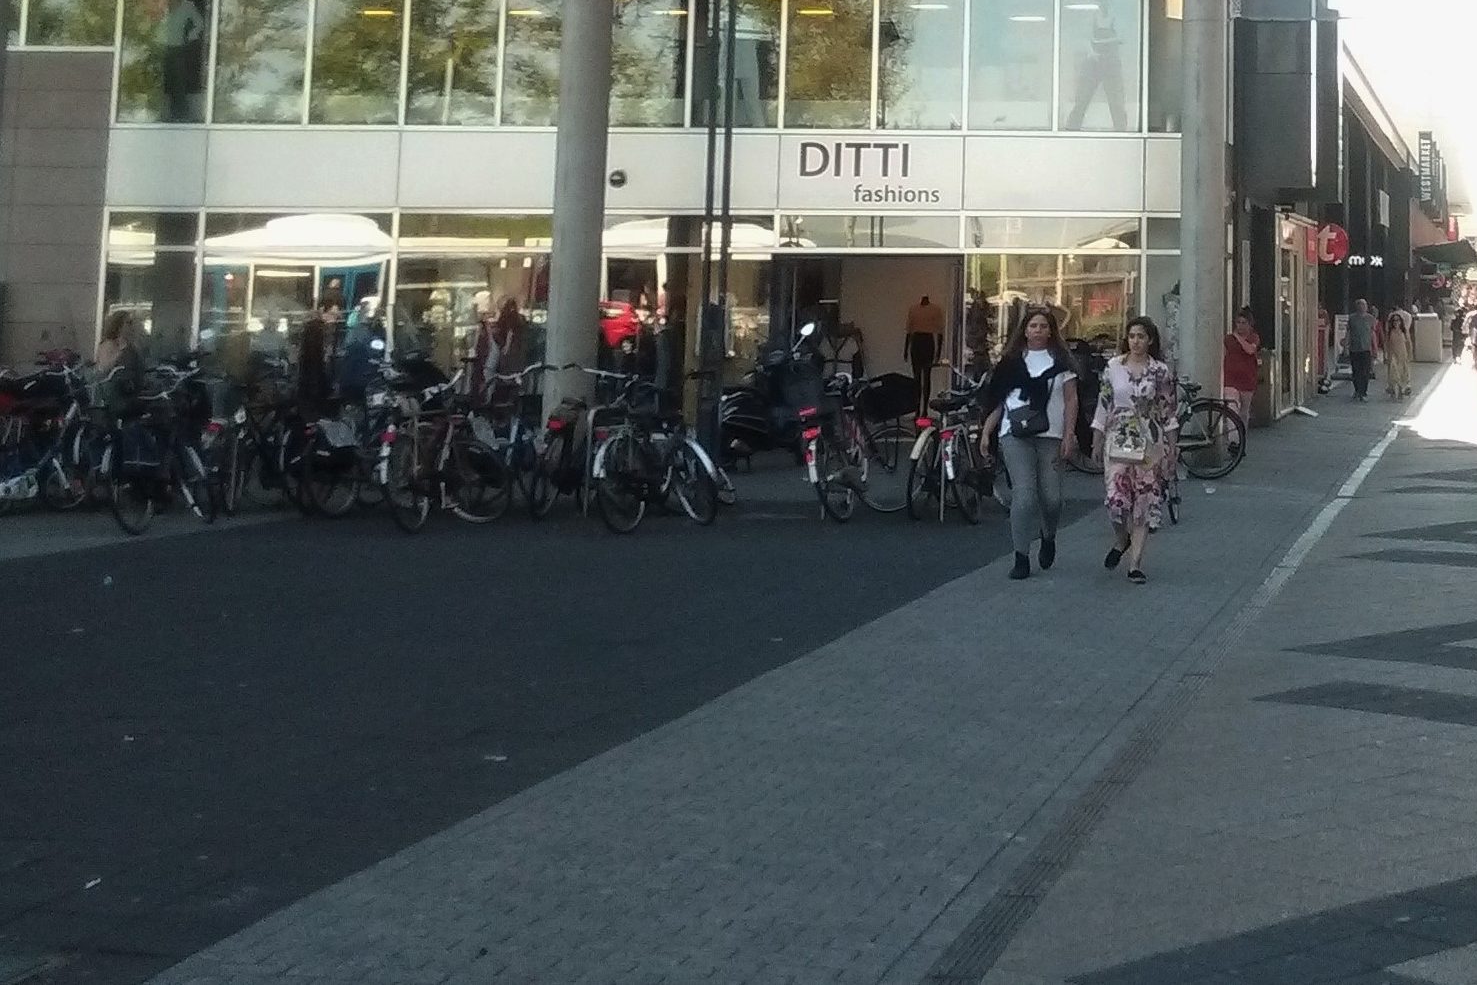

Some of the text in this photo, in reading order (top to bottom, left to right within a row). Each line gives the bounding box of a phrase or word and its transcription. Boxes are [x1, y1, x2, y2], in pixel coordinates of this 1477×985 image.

[798, 141, 911, 179] DITTI
[1420, 139, 1432, 201] WESTMARKET
[853, 183, 941, 204] fashions
